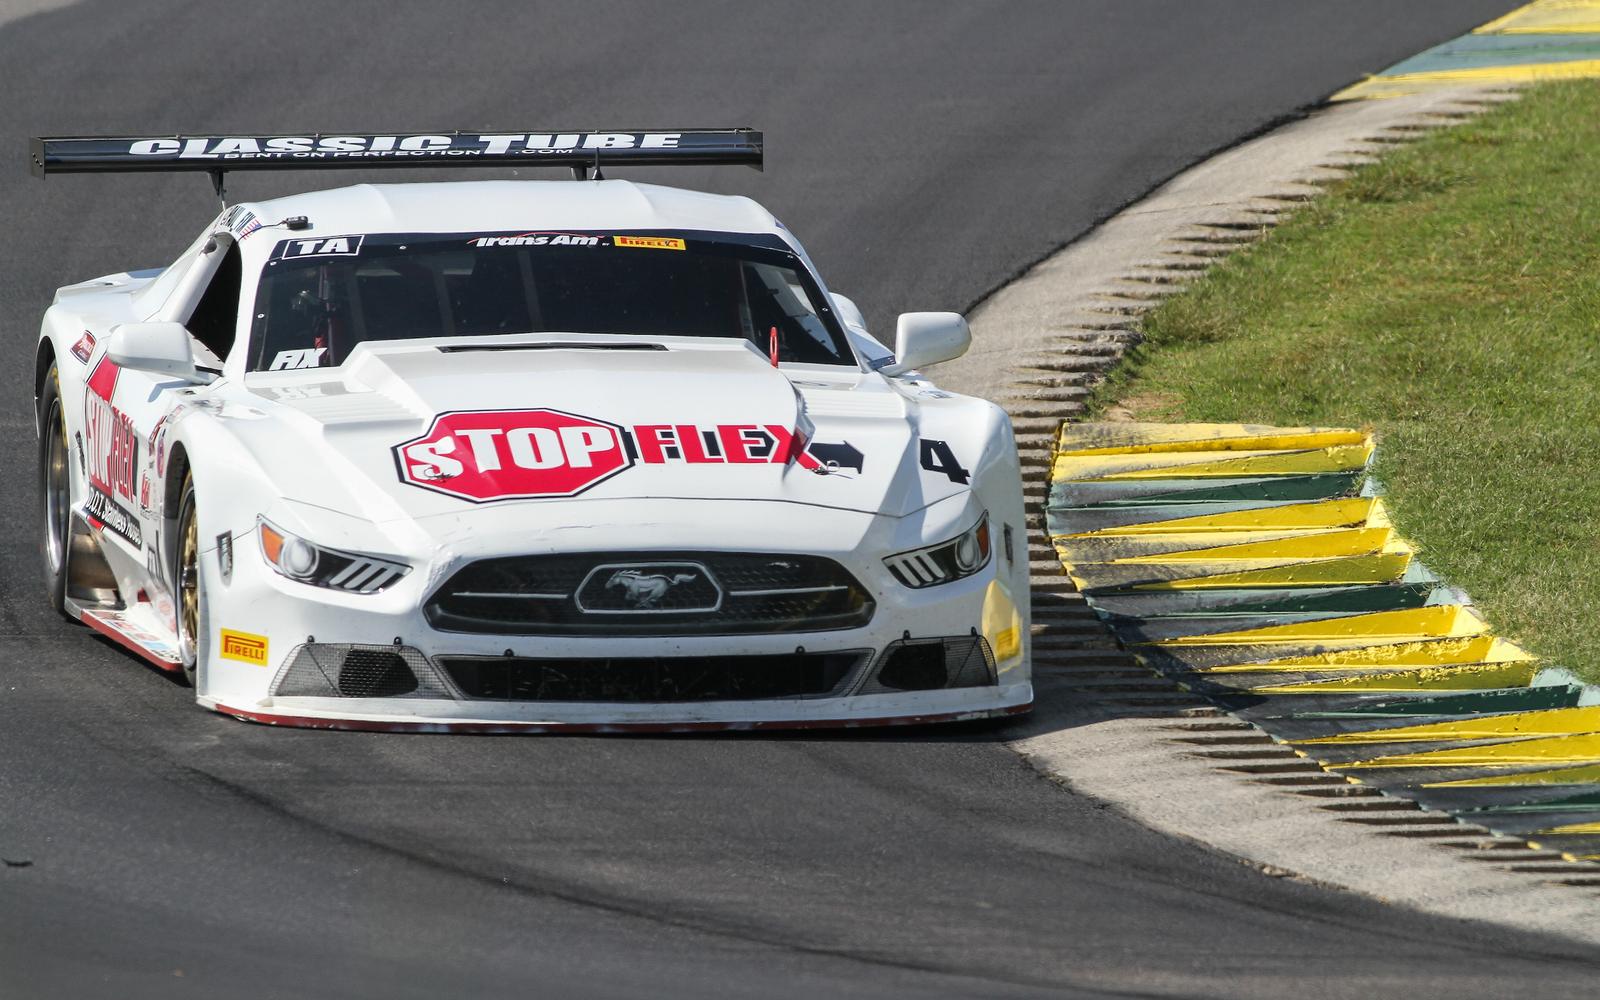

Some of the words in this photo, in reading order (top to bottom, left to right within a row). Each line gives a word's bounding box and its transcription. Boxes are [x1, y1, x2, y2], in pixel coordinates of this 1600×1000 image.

[129, 136, 453, 158] CLASSIC
[480, 134, 682, 154] TUBE
[297, 238, 349, 255] TA
[406, 427, 615, 481] STOP
[633, 424, 826, 471] FLEX
[919, 439, 971, 485] 4
[223, 634, 265, 661] PIRELLI
